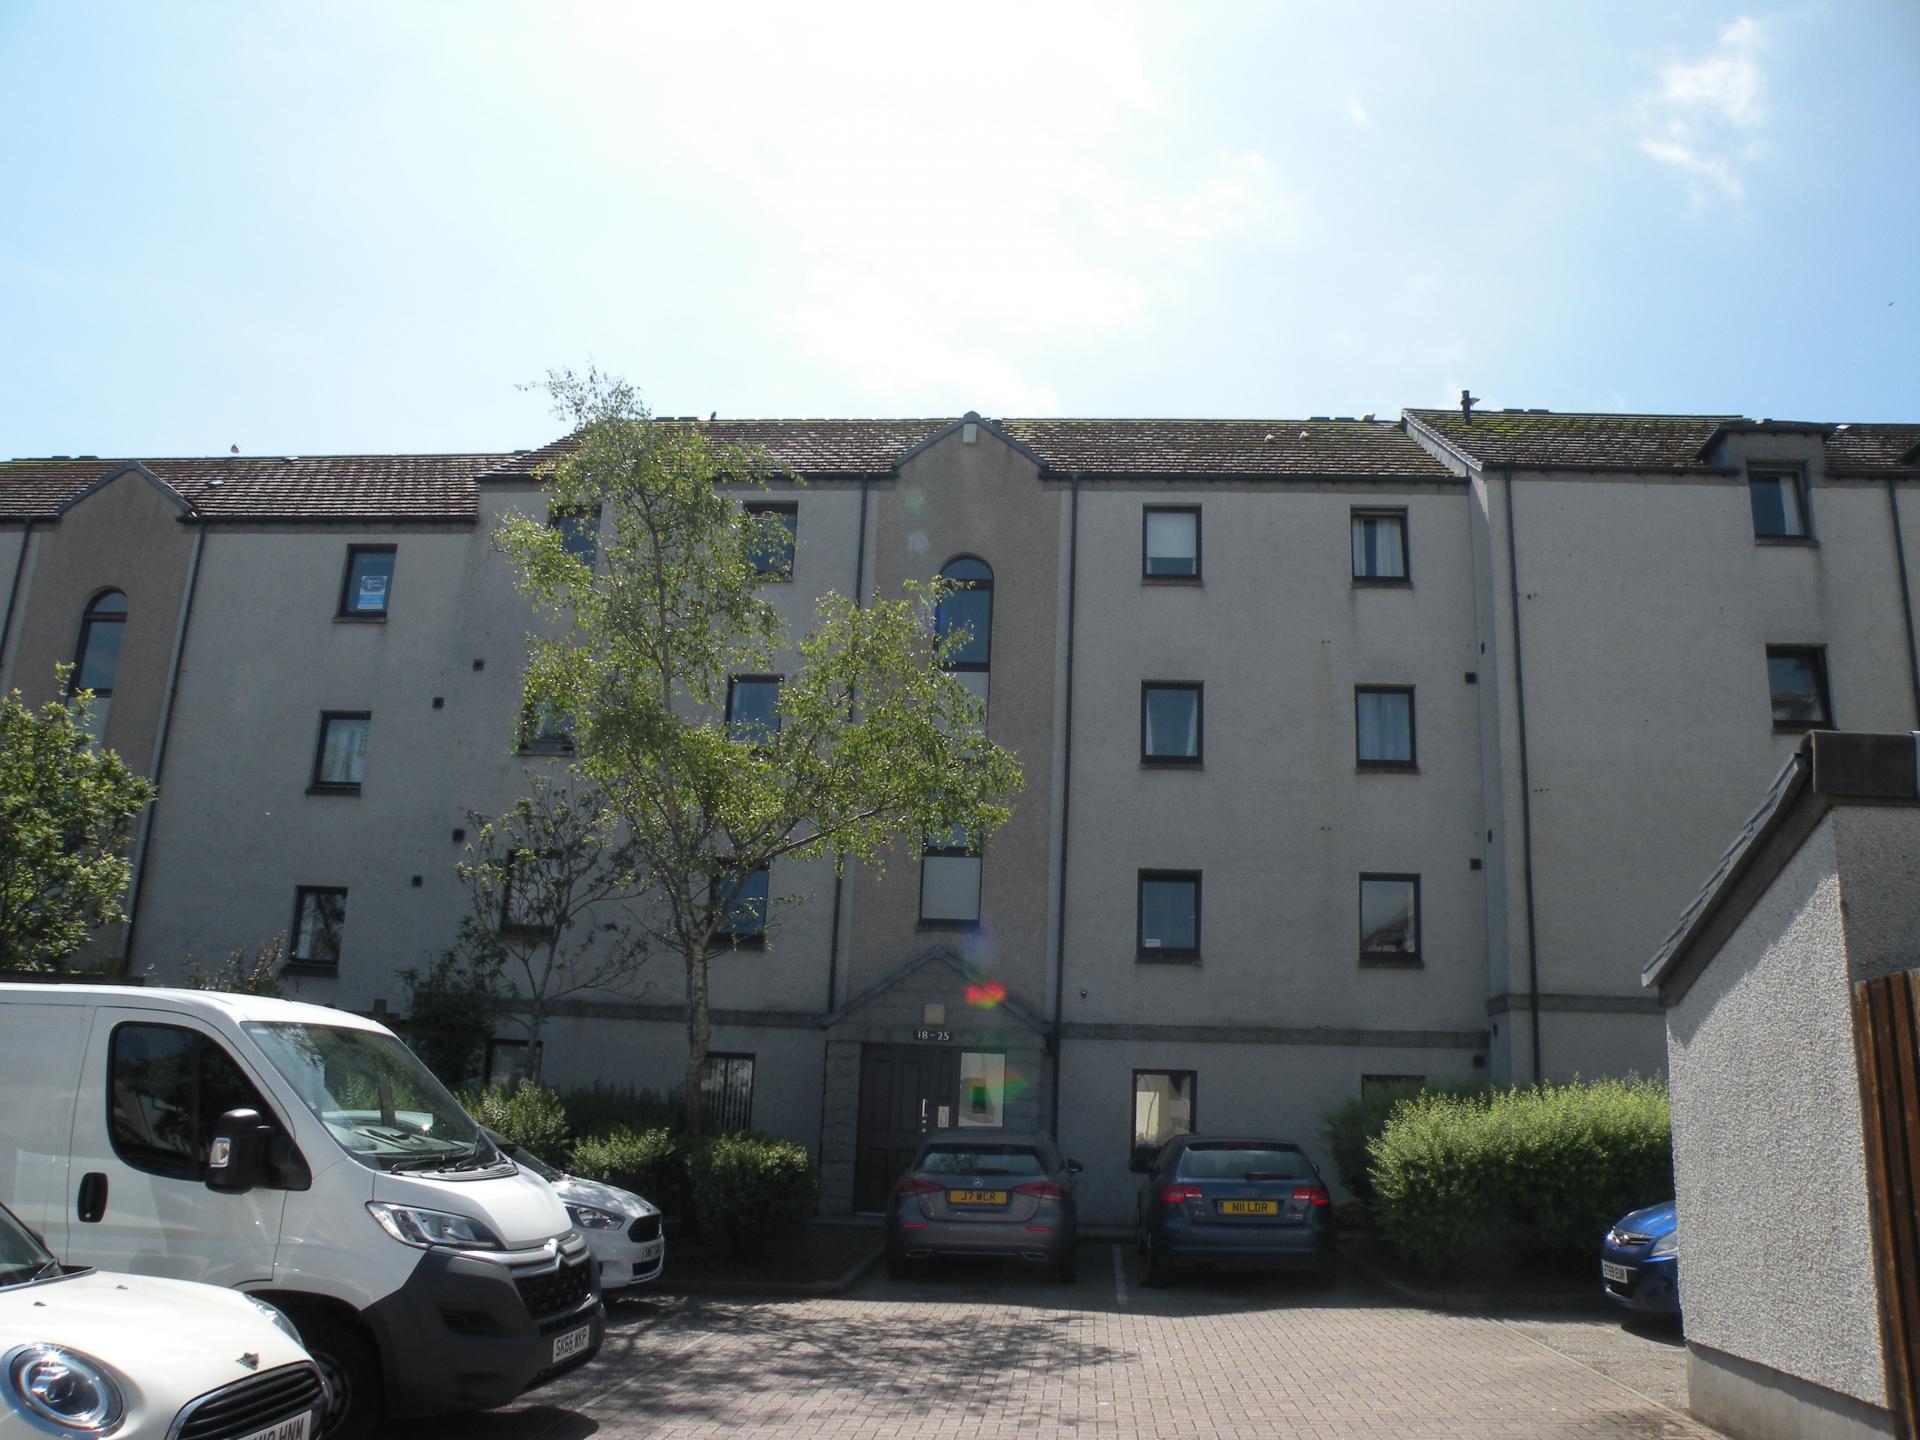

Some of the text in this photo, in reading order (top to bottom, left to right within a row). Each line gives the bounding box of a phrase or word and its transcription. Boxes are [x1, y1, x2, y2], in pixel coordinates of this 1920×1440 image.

[918, 1030, 950, 1041] 18-25
[960, 1191, 975, 1201] J7
[556, 1333, 574, 1357] SK66
